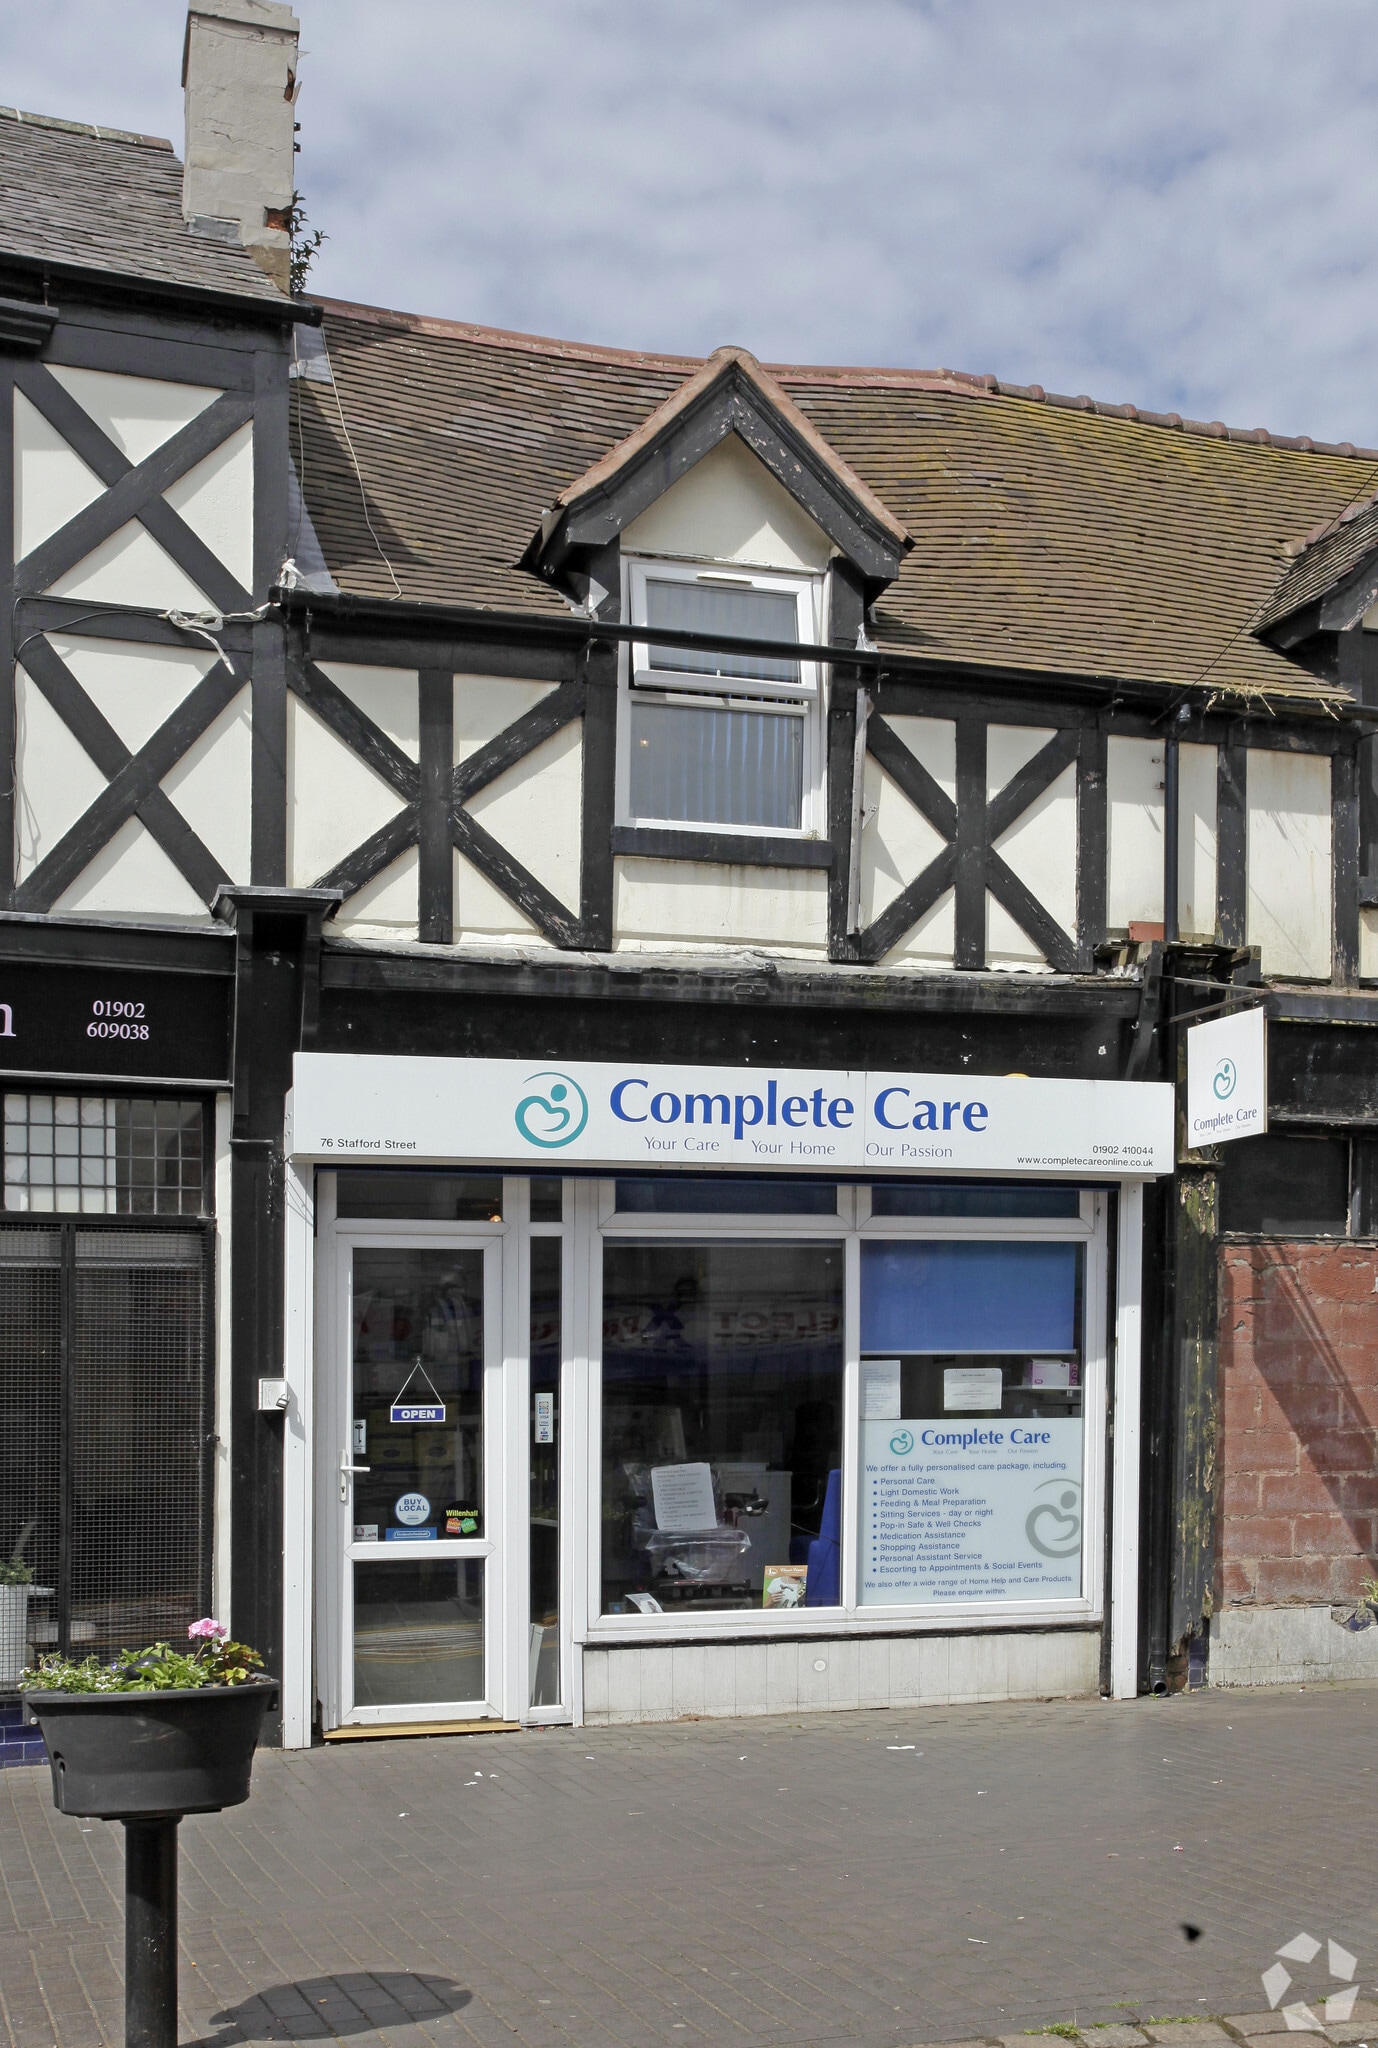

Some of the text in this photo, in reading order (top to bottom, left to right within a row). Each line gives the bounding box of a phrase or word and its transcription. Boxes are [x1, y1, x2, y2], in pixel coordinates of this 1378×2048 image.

[92, 1000, 145, 1018] 01902
[86, 1022, 149, 1040] 609038
[609, 1078, 989, 1140] Complete Care
[1193, 1112, 1234, 1131] Complete
[1236, 1108, 1257, 1121] Care
[320, 1137, 417, 1150] 76 Stafford Street
[644, 1136, 953, 1159] Your Care Your Home Our Passion
[1092, 1145, 1154, 1156] 01902 410044
[1017, 1155, 1154, 1168] www.completecareonline.co.uk
[401, 1410, 436, 1419] OPEN
[921, 1428, 1051, 1449] Complete Care
[880, 1464, 899, 1472] offer
[908, 1464, 923, 1473] fully
[926, 1463, 975, 1473] personalised
[997, 1463, 1030, 1472] package,
[880, 1477, 935, 1485] Personal Care
[880, 1487, 959, 1497] Light Domestic Work
[880, 1499, 911, 1508] Feeding
[943, 1498, 986, 1507] Preparation
[880, 1510, 904, 1519] Sitting
[907, 1509, 941, 1517] Services
[948, 1509, 962, 1518] day
[975, 1509, 993, 1517] night
[953, 1519, 981, 1527] Checks
[880, 1531, 966, 1540] Medication Assistance
[880, 1542, 960, 1553] Shopping Assistance
[880, 1552, 982, 1562] Personal Assistant Service
[880, 1565, 917, 1574] Escorting
[929, 1563, 981, 1573] Appointments
[1018, 1561, 1043, 1569] Events
[938, 1579, 958, 1587] range
[991, 1577, 1006, 1585] Help
[958, 1589, 983, 1597] enquire
